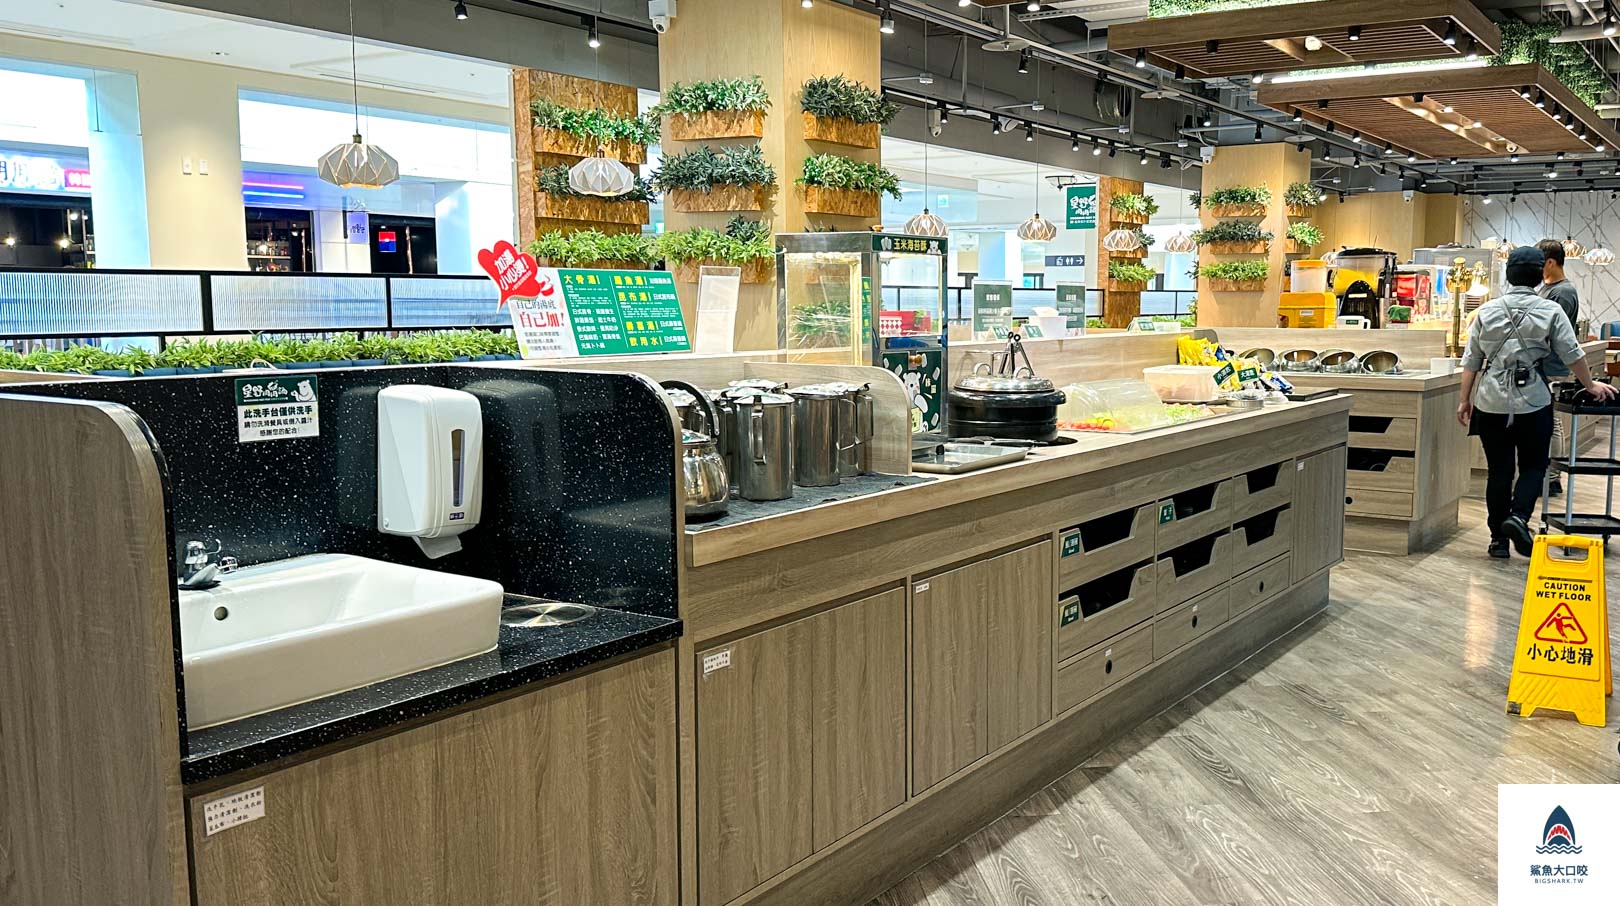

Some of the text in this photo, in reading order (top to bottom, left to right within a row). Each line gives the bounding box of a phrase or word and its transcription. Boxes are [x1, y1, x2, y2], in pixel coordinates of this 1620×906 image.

[519, 311, 565, 328] 自己加!
[243, 405, 313, 419] 此洗手台僅供洗手
[1544, 582, 1586, 592] CAUTION
[1536, 591, 1592, 602] WET FLOOR
[1526, 643, 1594, 666] 小心地滑
